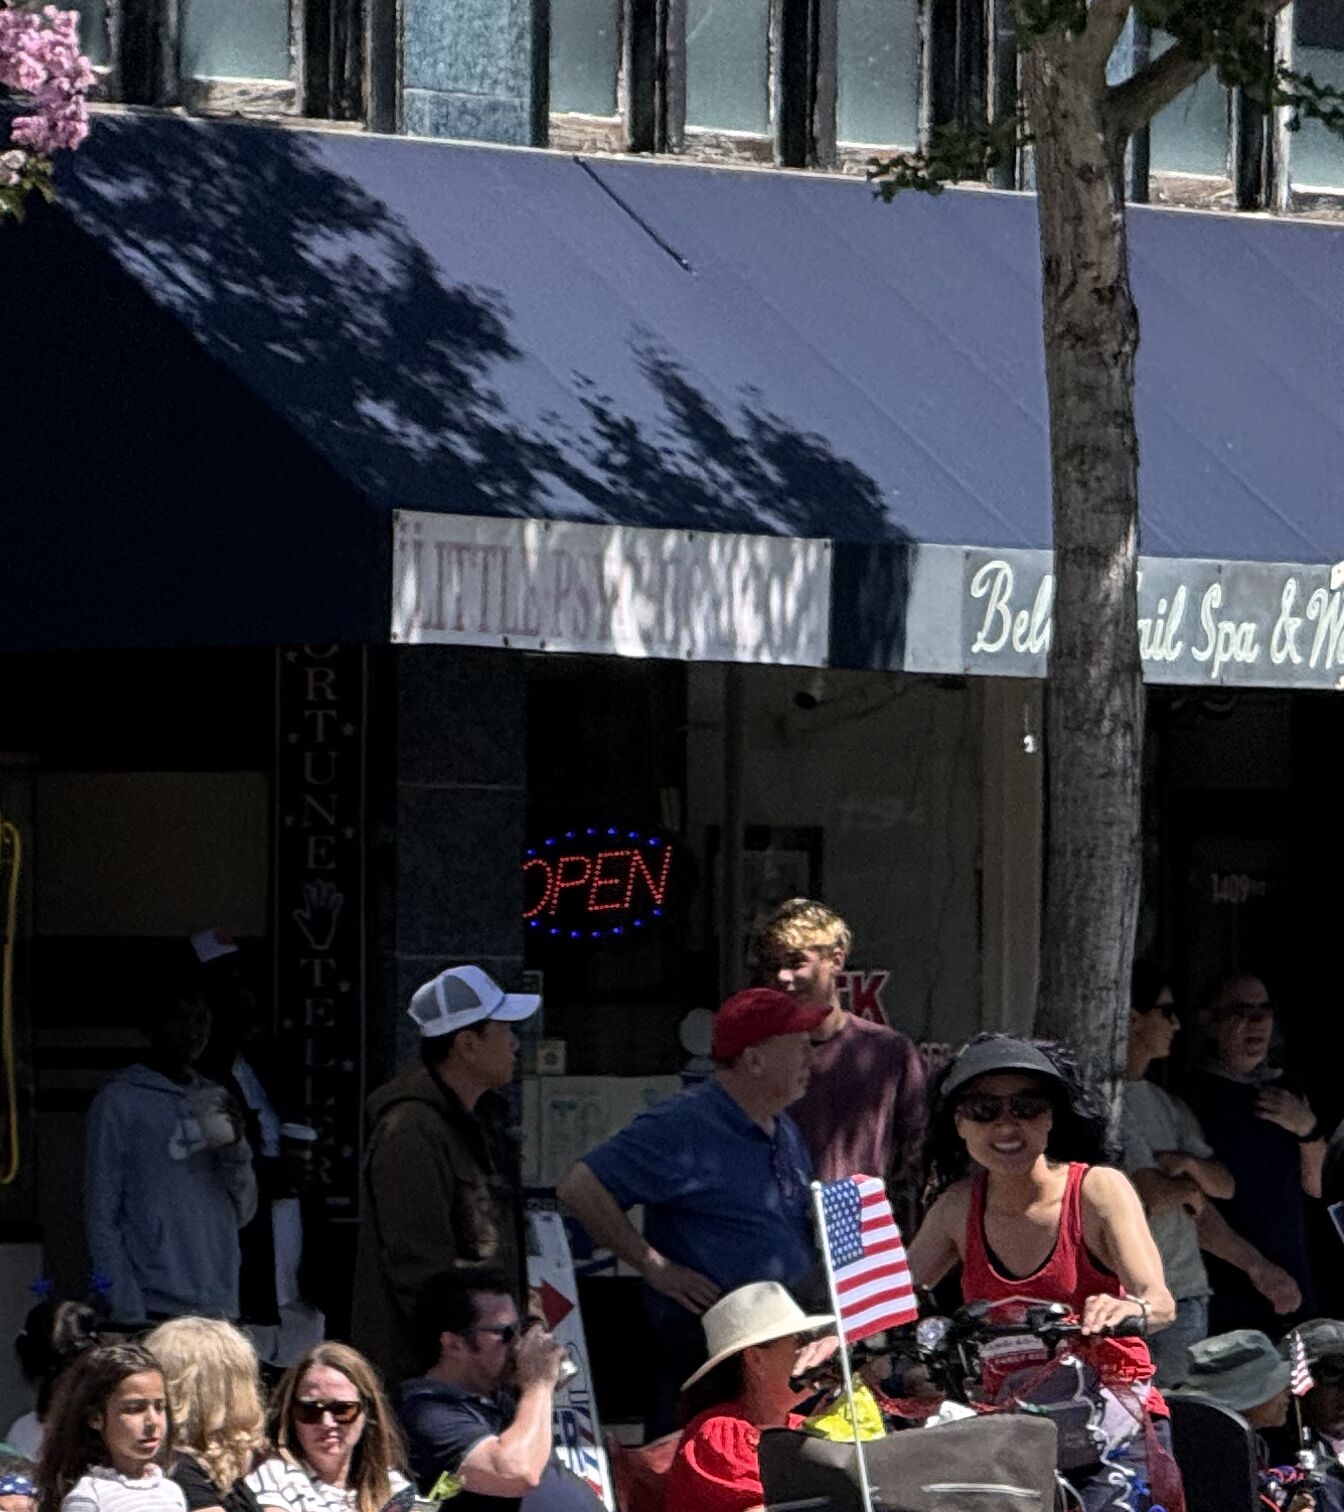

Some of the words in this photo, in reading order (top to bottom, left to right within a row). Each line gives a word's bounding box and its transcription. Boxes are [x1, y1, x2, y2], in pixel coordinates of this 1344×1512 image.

[1137, 570, 1187, 662] ail
[1191, 583, 1260, 679] Spa
[1270, 577, 1303, 664] &
[521, 845, 673, 919] OPEN
